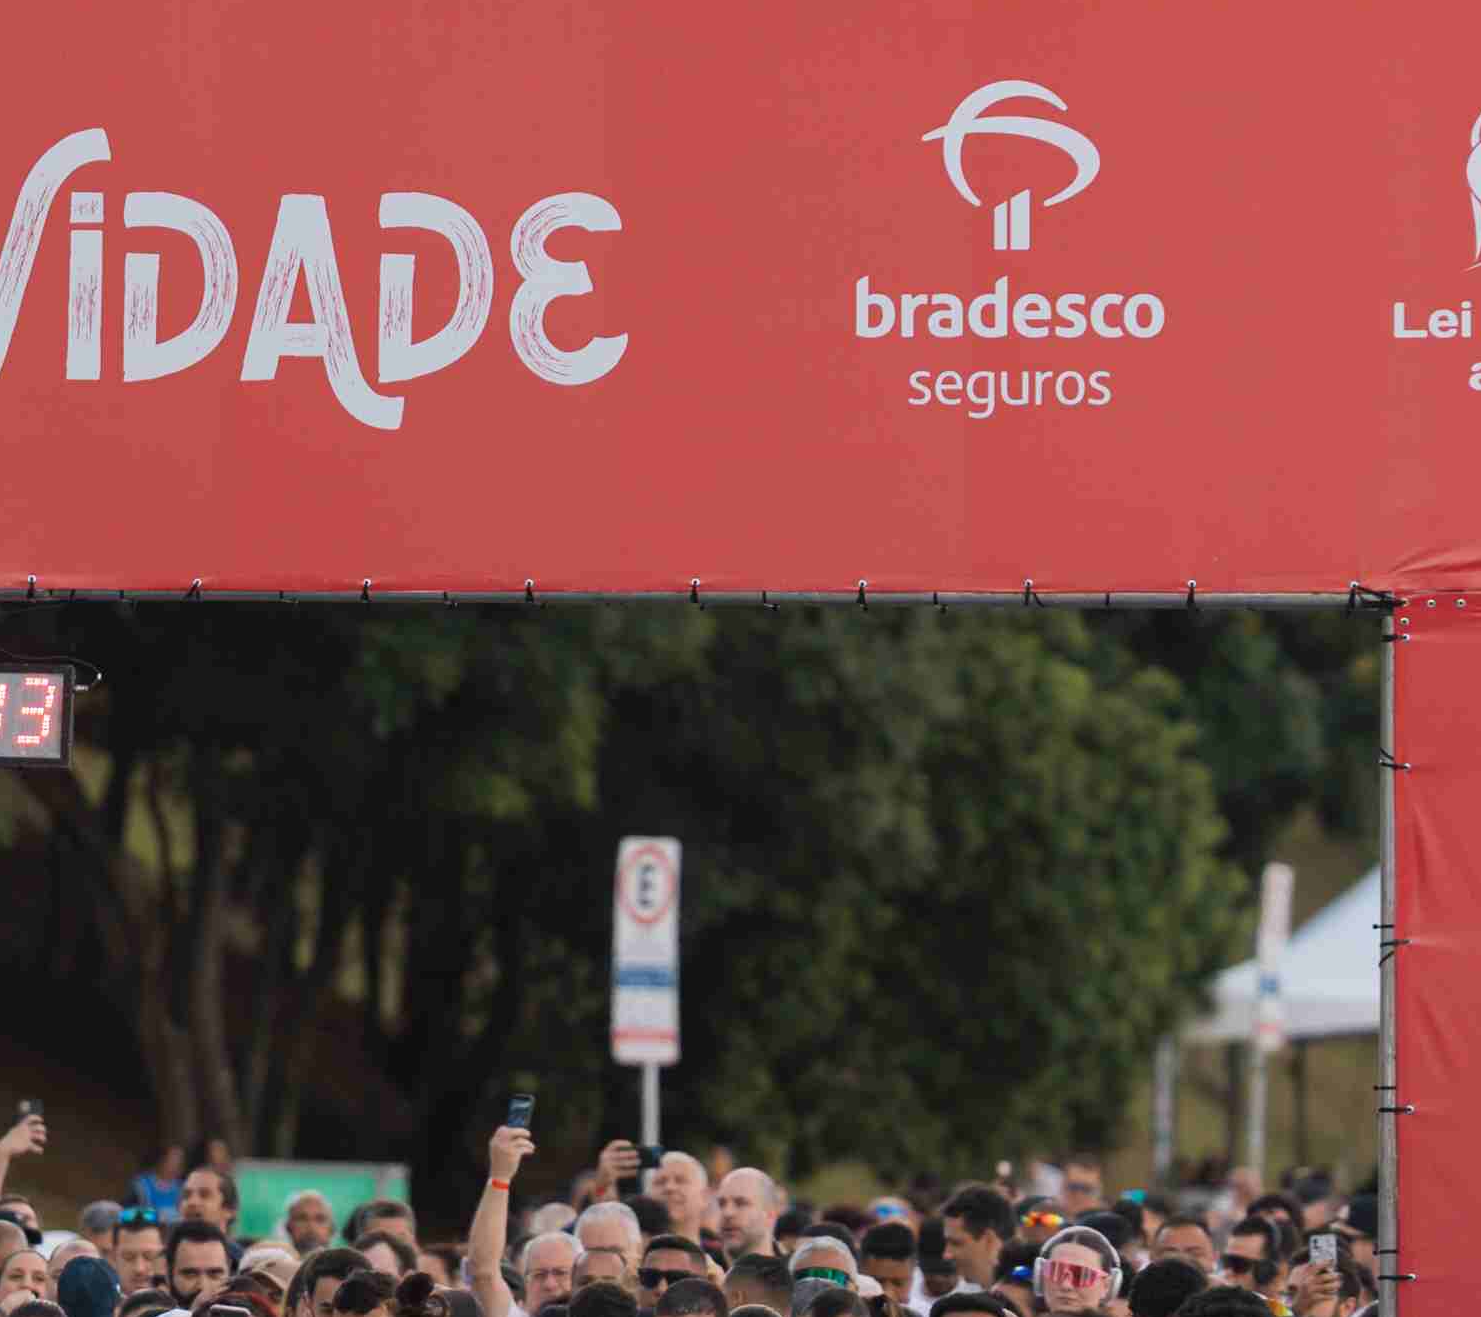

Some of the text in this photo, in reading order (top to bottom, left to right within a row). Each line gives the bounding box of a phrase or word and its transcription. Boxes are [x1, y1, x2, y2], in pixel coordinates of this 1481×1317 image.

[855, 275, 1165, 339] bradesco
[1393, 300, 1472, 339] Lei
[907, 370, 1112, 419] seguros
